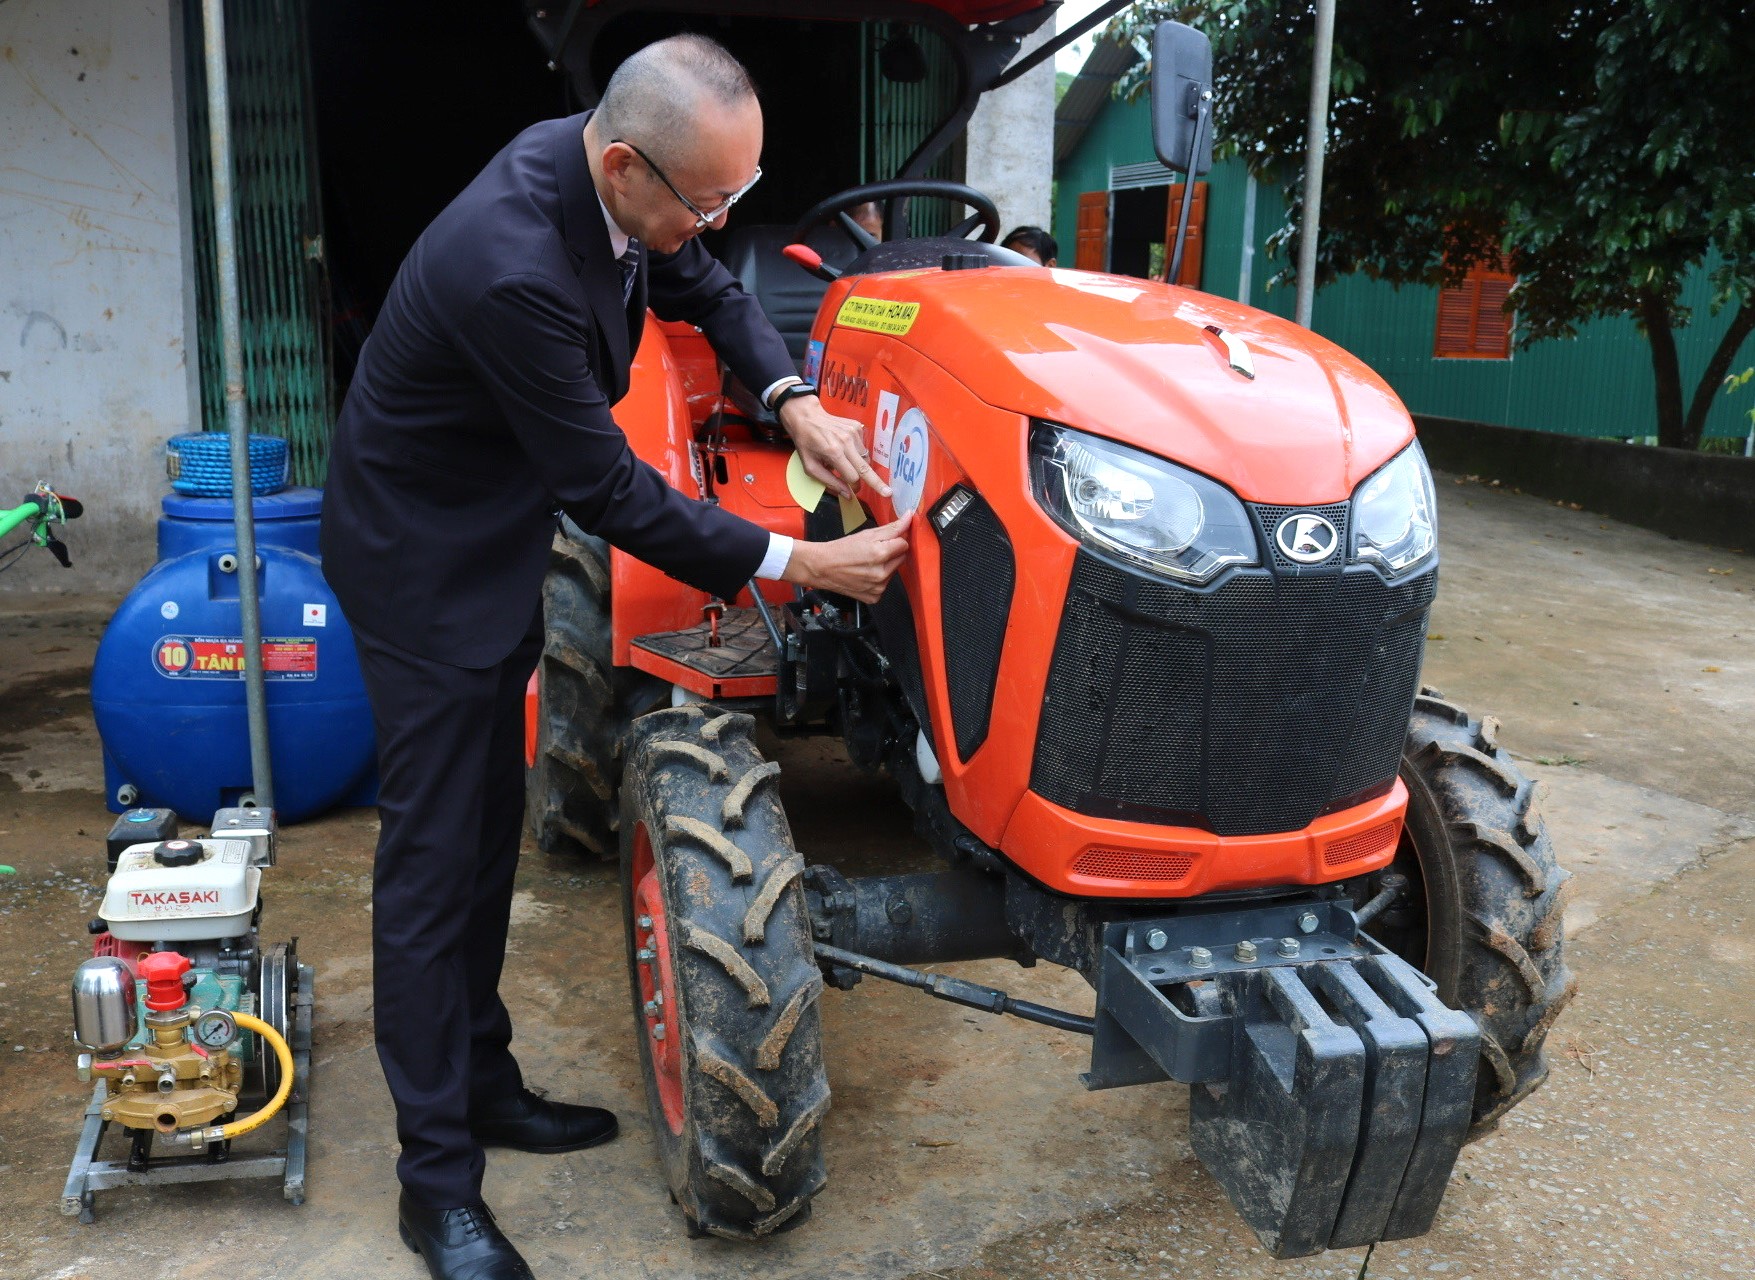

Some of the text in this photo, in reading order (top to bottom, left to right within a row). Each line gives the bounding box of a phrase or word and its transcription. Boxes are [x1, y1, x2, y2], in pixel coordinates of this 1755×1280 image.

[823, 359, 868, 407] Kubota
[161, 646, 188, 667] 10
[197, 653, 234, 671] TÂN
[131, 890, 219, 906] TAKASAKI
